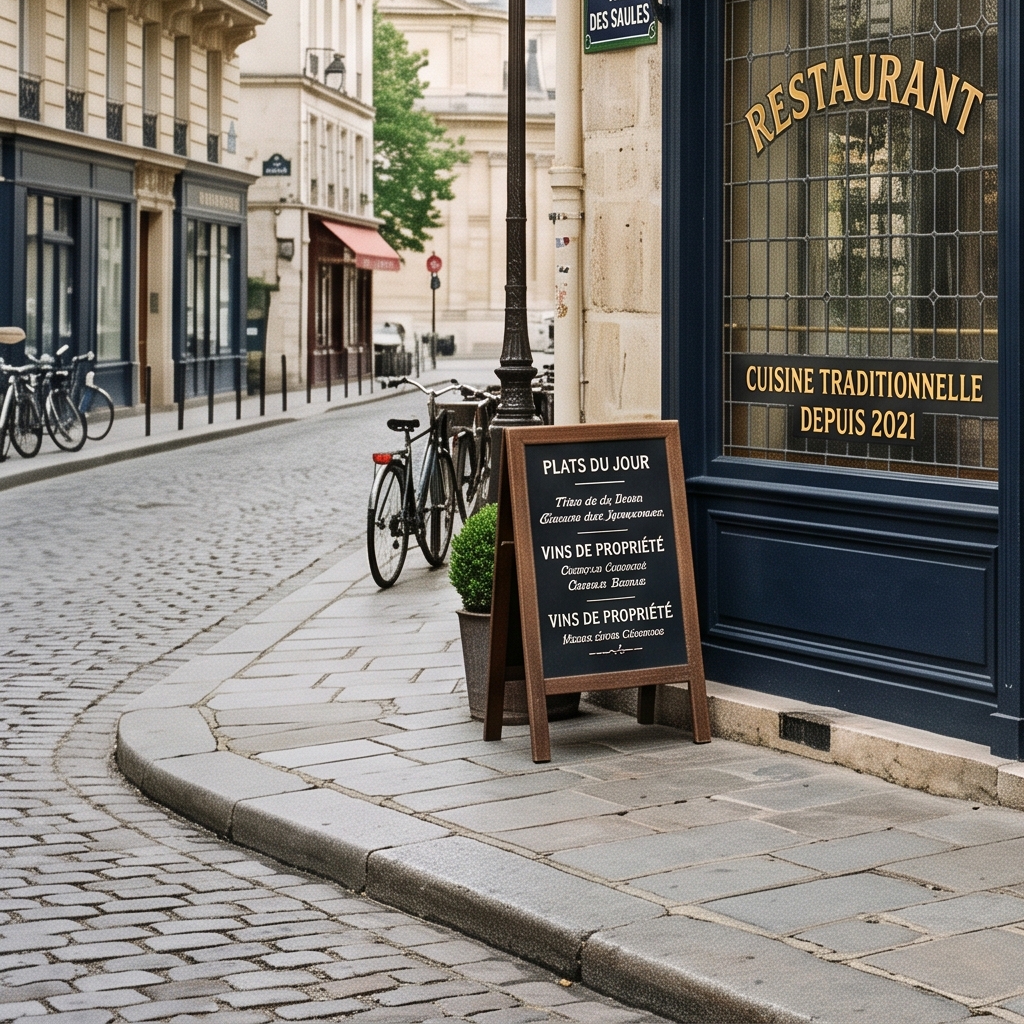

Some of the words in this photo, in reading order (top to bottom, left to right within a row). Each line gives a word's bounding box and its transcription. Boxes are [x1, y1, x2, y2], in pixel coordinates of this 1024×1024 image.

[589, 10, 609, 31] DES
[611, 3, 650, 28] SAULES
[744, 53, 984, 154] RESTAURANT
[746, 365, 815, 394] CUISINE
[819, 368, 983, 403] TRADITIONNELLE
[800, 406, 866, 436] DEPUIS
[871, 409, 916, 440] 2021
[542, 458, 586, 475] PLATS
[589, 456, 609, 472] DU
[612, 455, 650, 471] JOUR
[541, 545, 572, 560] VINS
[575, 543, 593, 558] DE
[595, 535, 665, 557] PROPRIÉTÉ
[548, 612, 580, 628] VINS
[583, 611, 601, 626] DE
[602, 600, 674, 624] PROPRIÉTÉ
